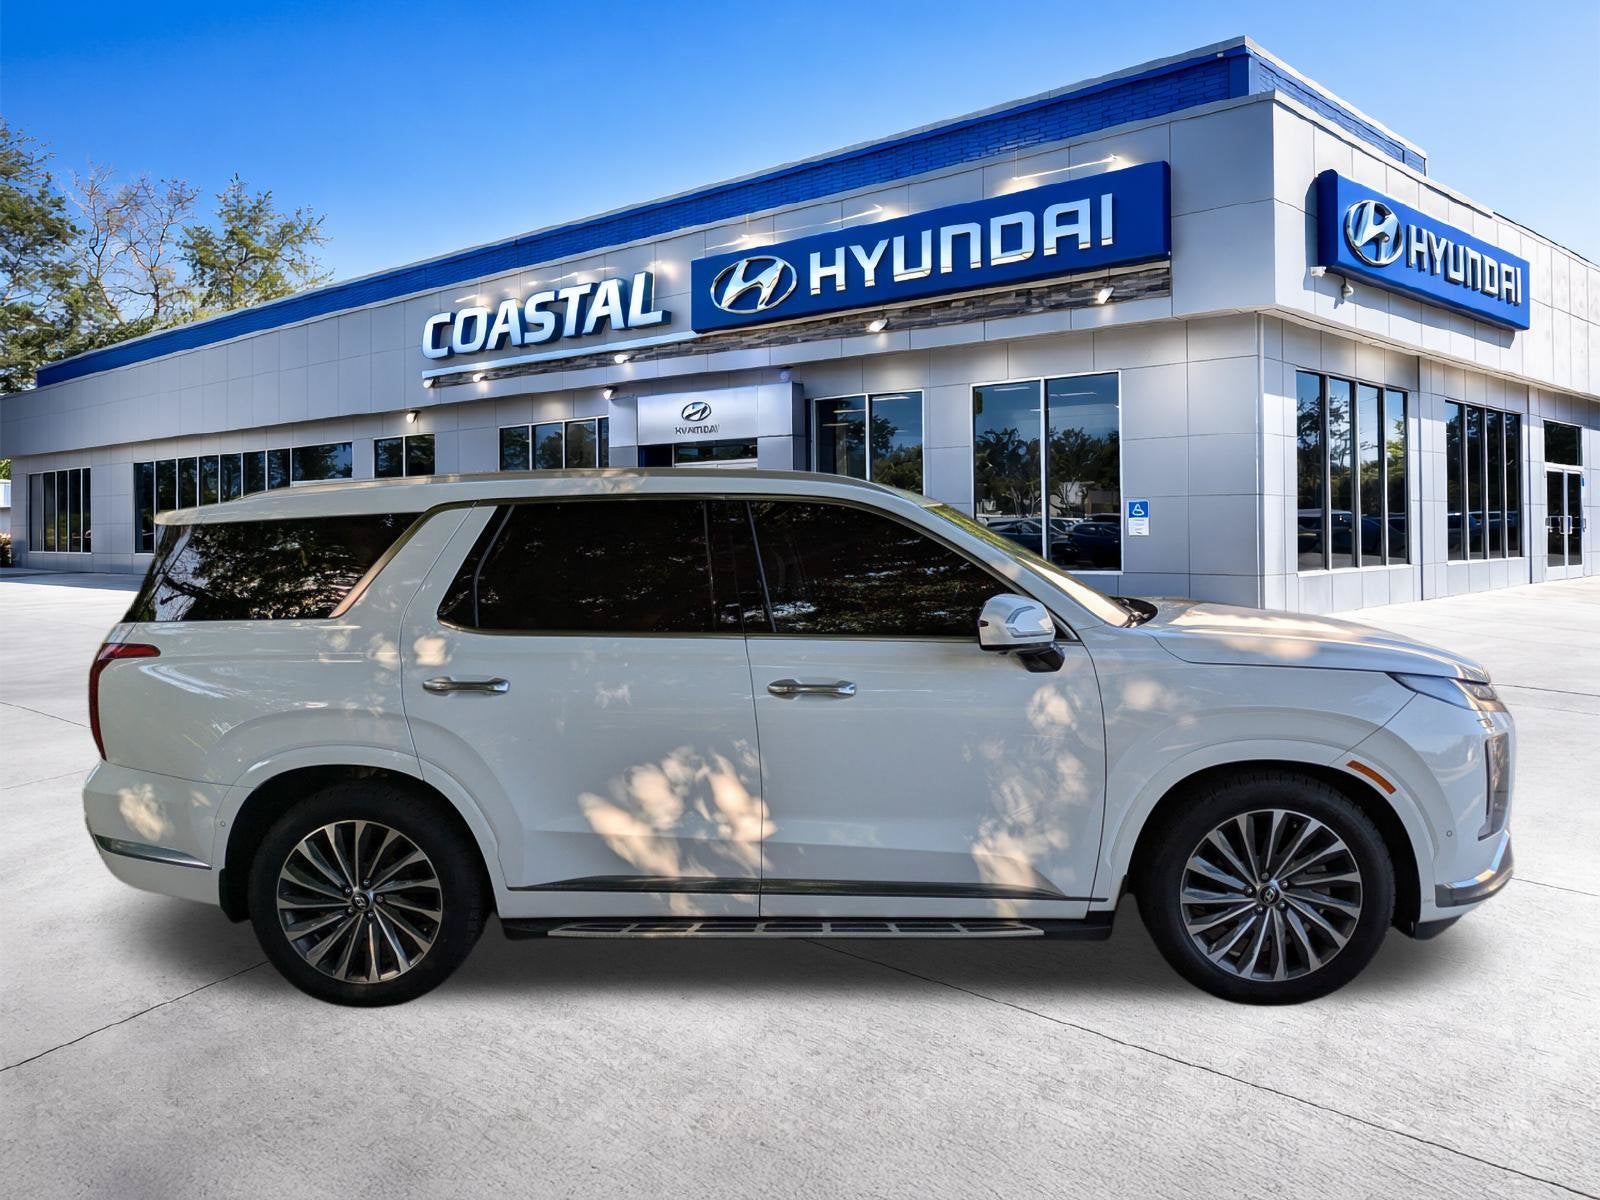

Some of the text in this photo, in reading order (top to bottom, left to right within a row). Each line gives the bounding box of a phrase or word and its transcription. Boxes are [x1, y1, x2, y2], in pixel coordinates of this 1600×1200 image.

[809, 193, 1114, 295] HYUNDAI
[1406, 224, 1522, 306] HYUNDAI
[422, 271, 672, 360] COASTAL
